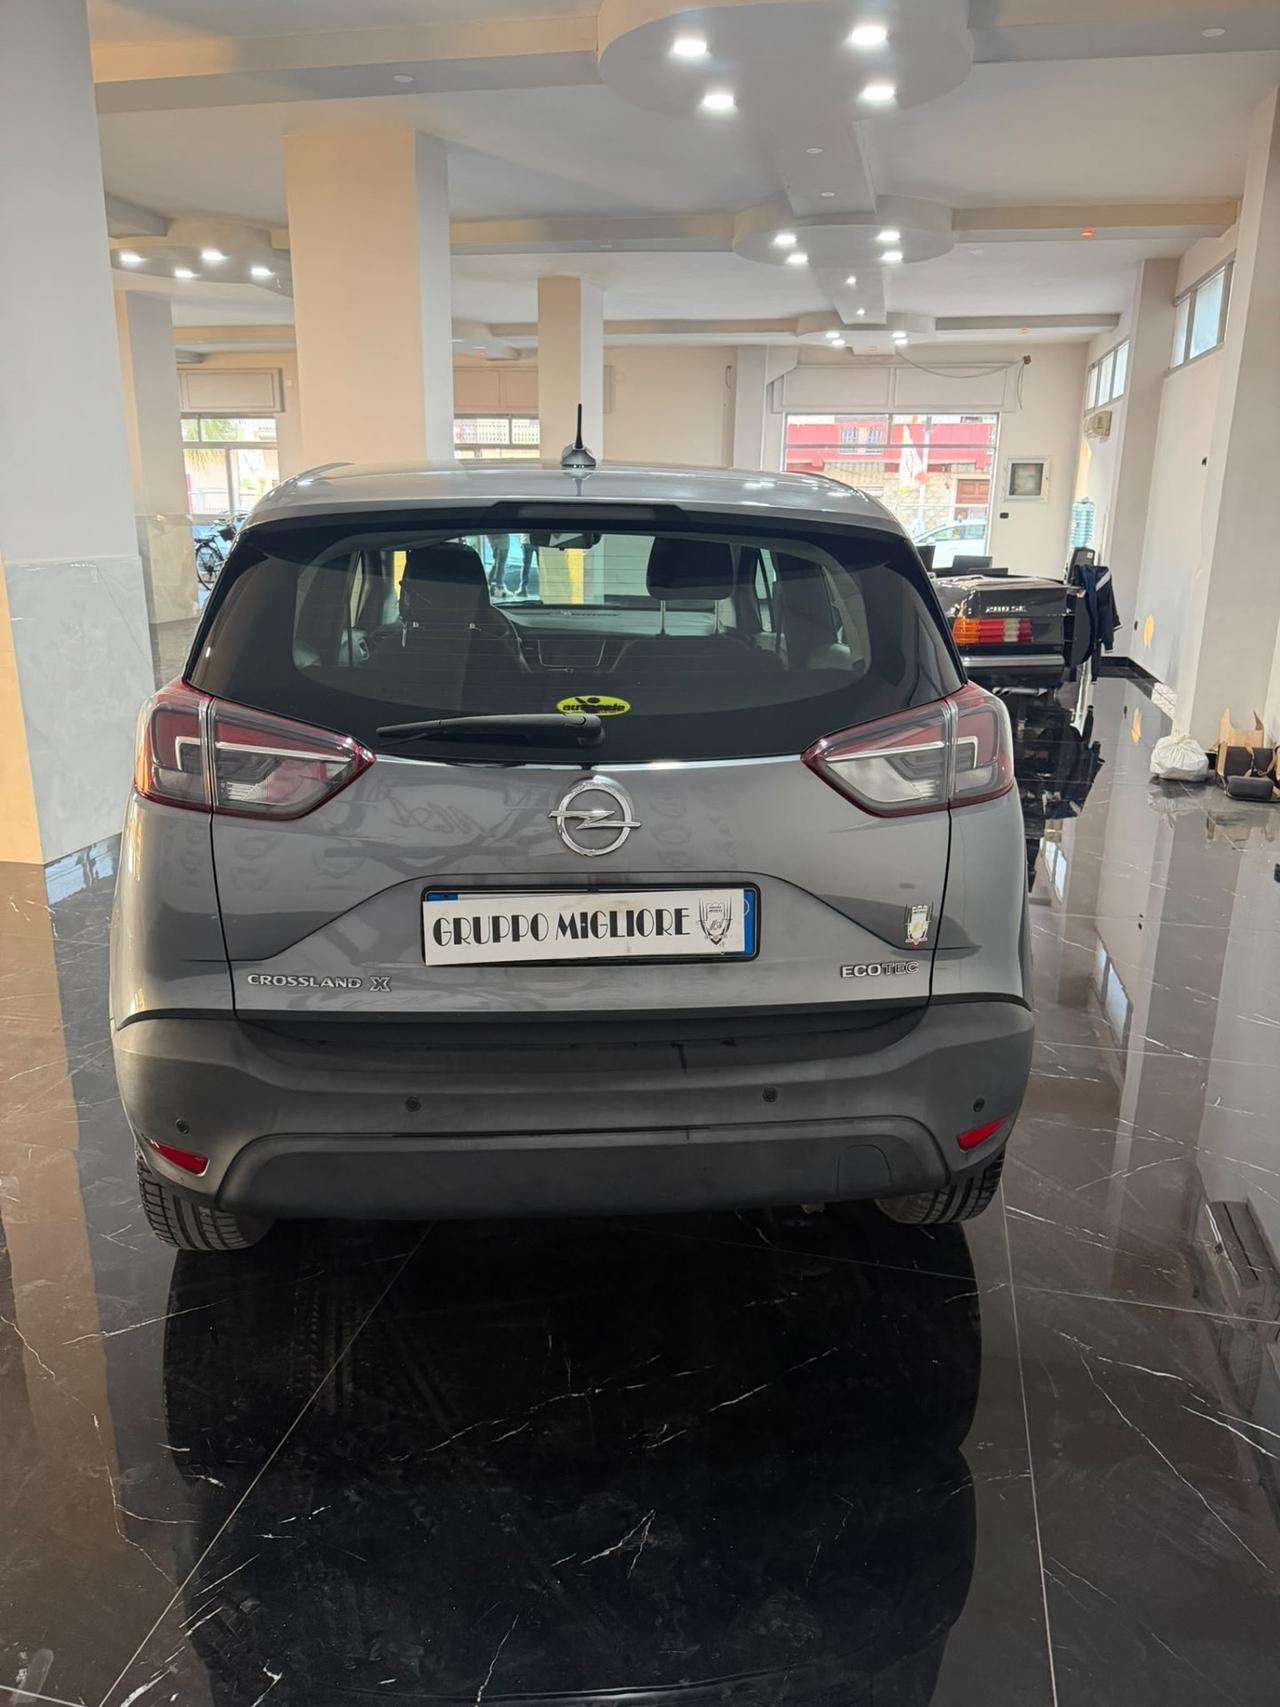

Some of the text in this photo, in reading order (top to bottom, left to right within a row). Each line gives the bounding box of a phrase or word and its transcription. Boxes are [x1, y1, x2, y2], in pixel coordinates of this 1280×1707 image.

[432, 907, 691, 947] GRUPPO MIGLIORE
[841, 960, 920, 978] ECOTEC
[247, 974, 392, 992] CROSSLAND X
